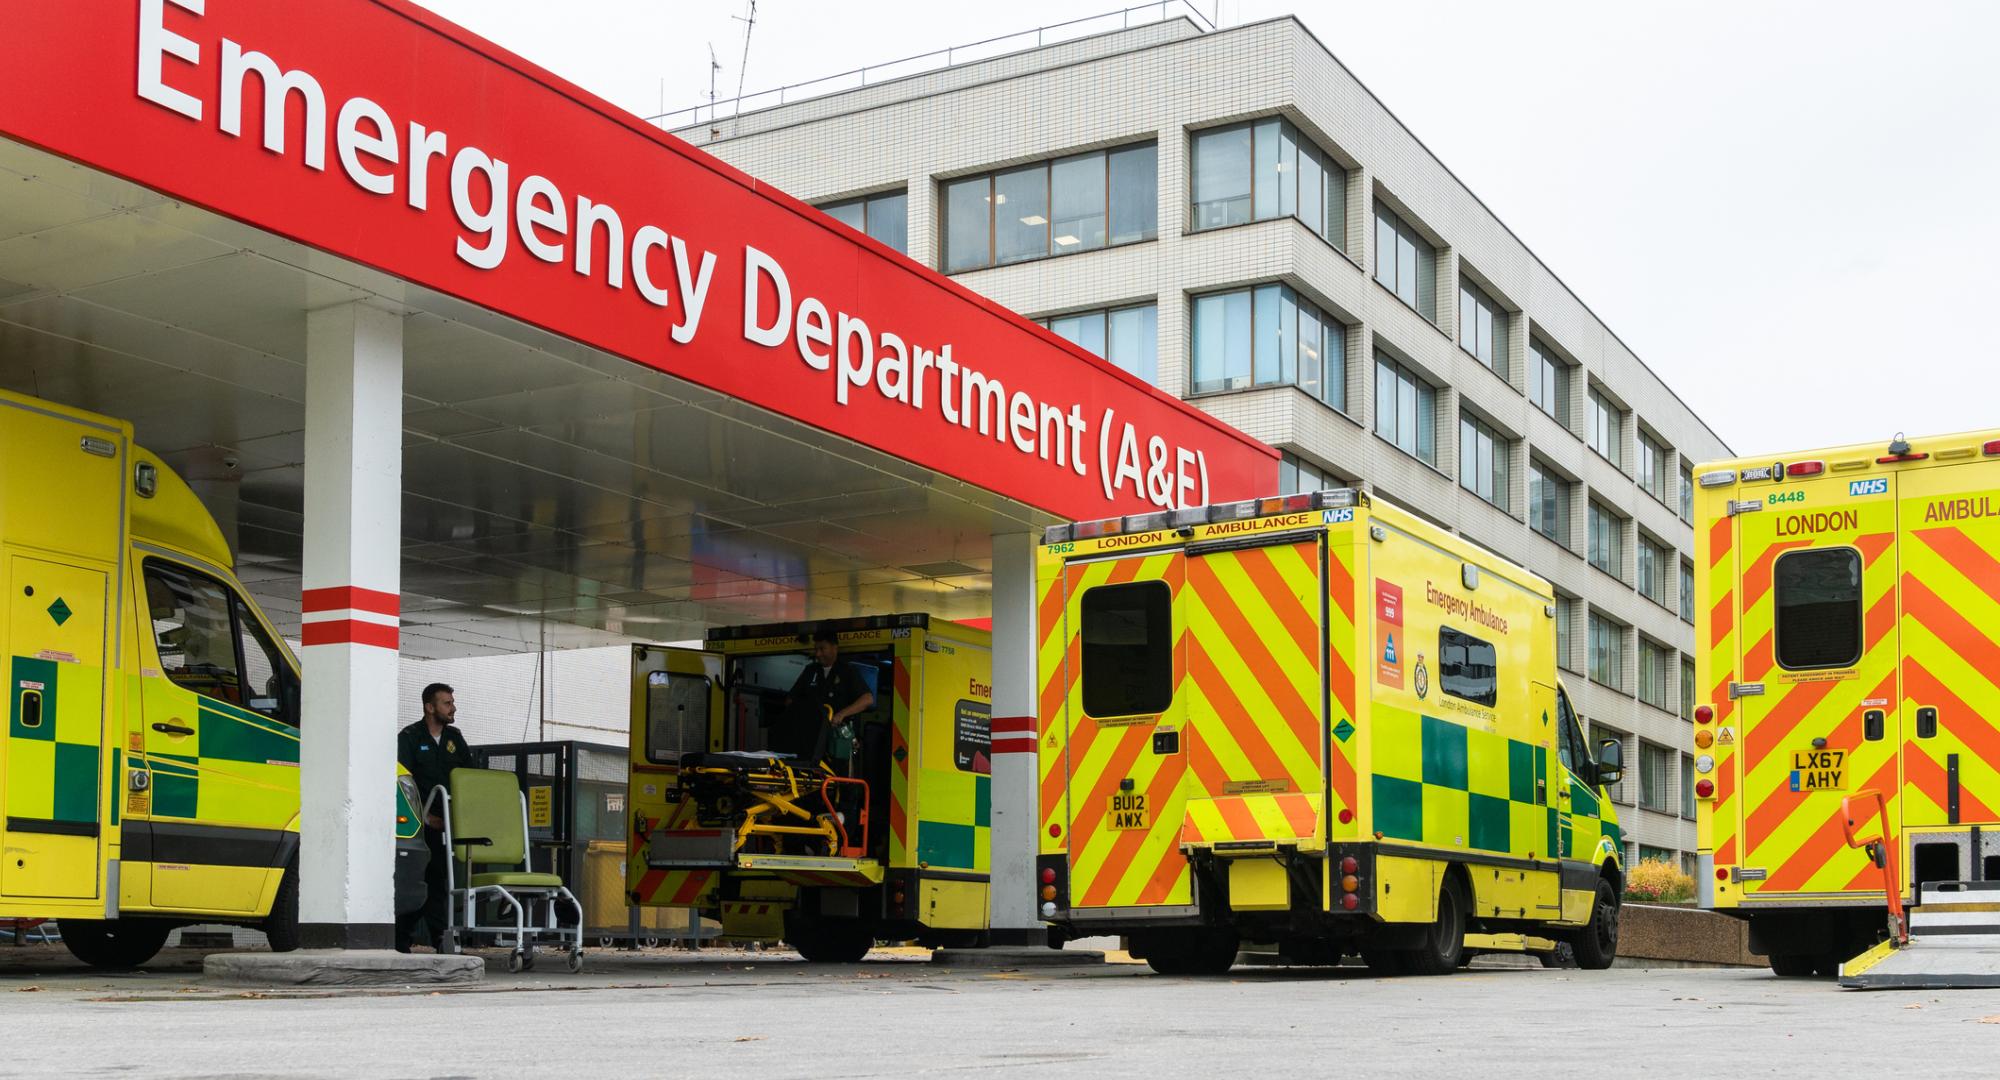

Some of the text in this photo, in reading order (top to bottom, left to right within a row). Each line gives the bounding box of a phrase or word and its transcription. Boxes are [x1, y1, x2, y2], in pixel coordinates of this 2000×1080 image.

[138, 0, 1209, 512] Emergency Department (A&E)
[1768, 479, 1887, 505] 8448 NHS
[1776, 496, 2000, 536] LONDON AMBUL
[1048, 508, 1353, 554] 7962 LONDON AMBULANCE NHS
[1427, 580, 1508, 635] Emergency Ambulance
[891, 628, 911, 639] NHS
[1796, 752, 1843, 769] LX67
[1807, 771, 1842, 788] AHY
[1113, 796, 1144, 810] BU12
[1116, 813, 1142, 828] AWX
